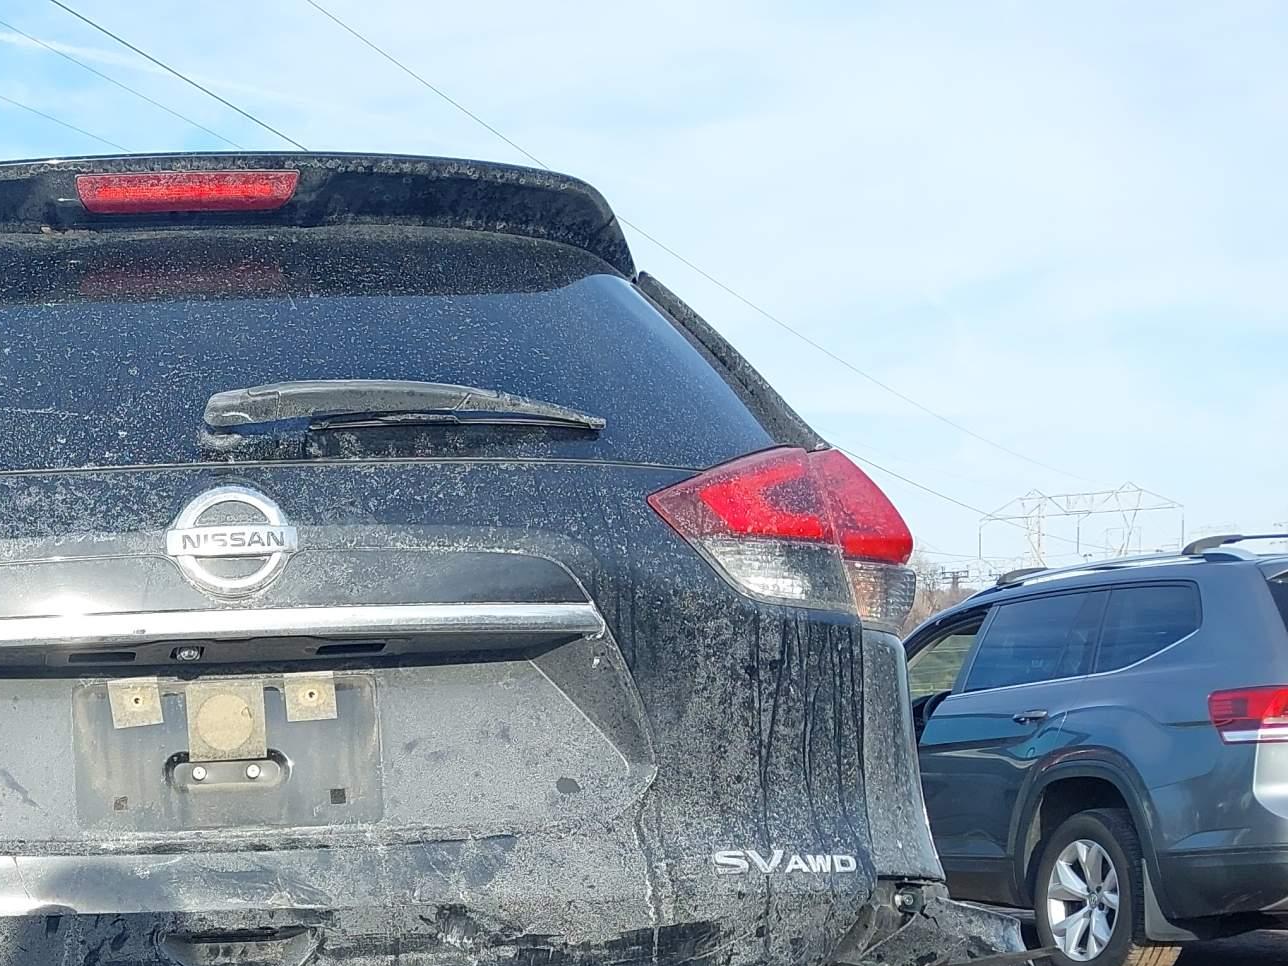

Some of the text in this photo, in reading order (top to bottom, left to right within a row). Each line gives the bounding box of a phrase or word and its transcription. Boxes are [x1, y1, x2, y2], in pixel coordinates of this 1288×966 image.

[182, 531, 285, 549] NISSAN
[712, 849, 857, 874] SV AWD
